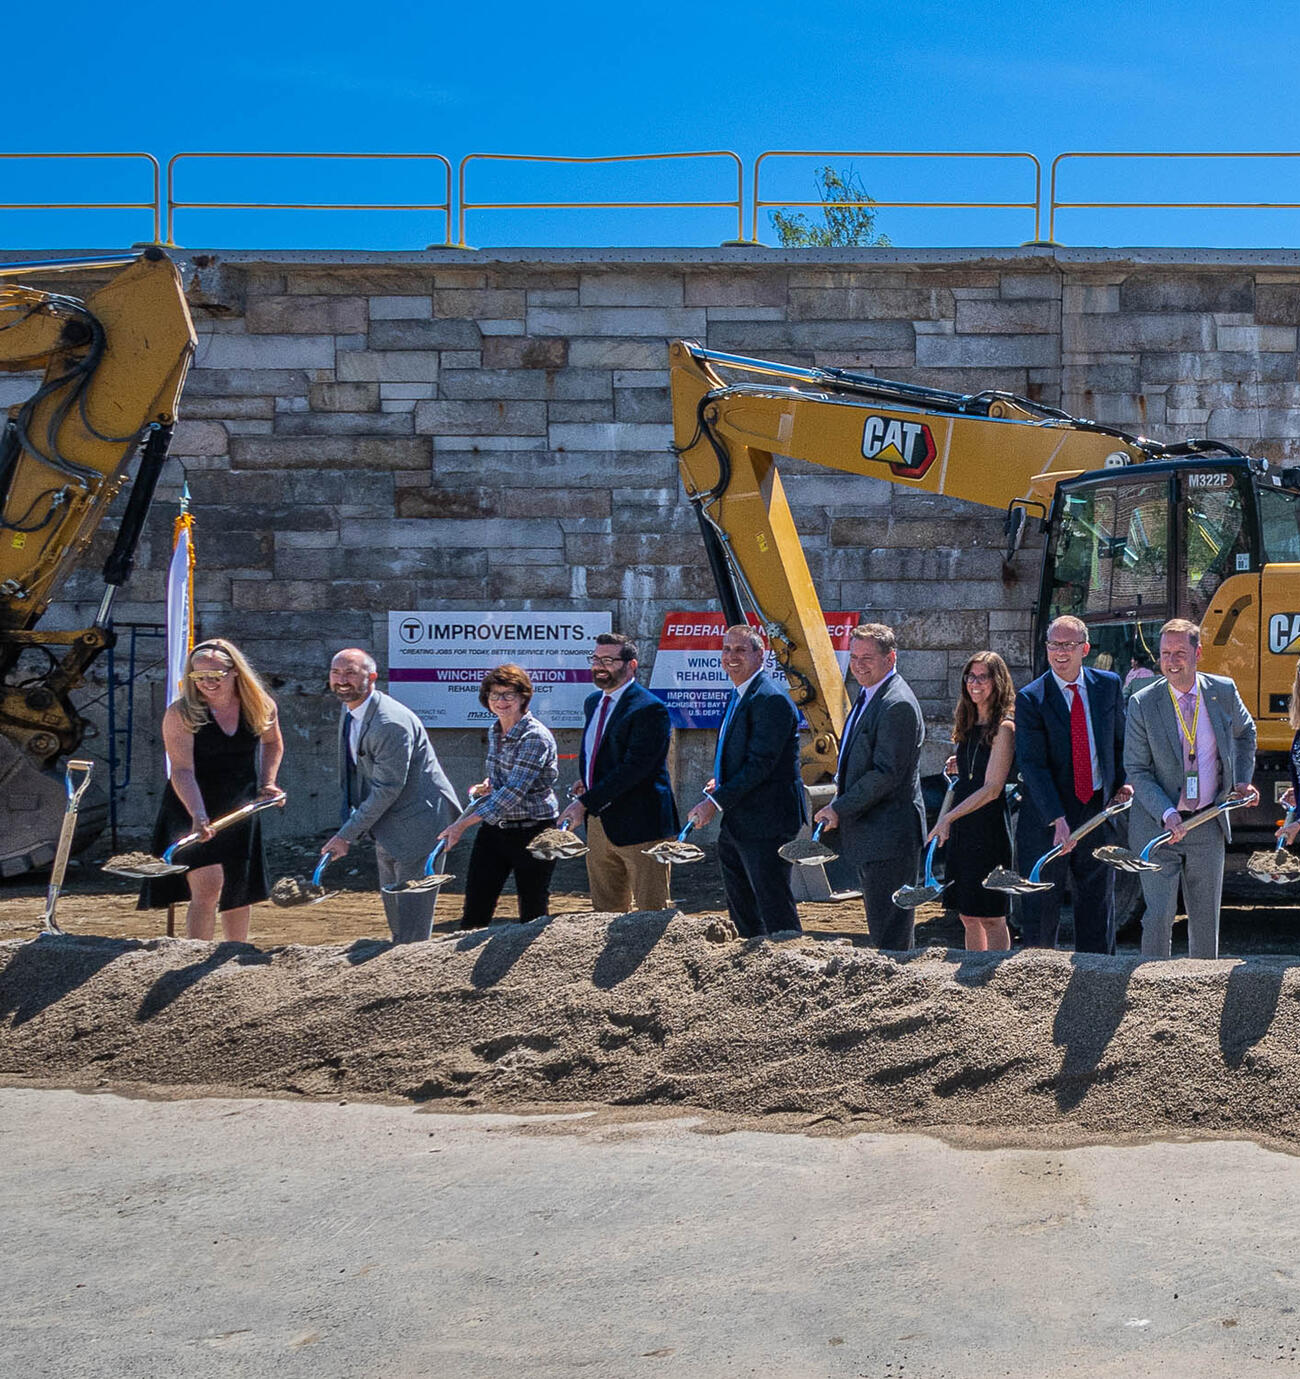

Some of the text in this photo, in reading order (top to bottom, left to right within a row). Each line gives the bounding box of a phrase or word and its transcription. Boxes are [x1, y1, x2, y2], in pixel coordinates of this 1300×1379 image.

[862, 416, 922, 465] CAT
[1188, 473, 1228, 488] M322F
[667, 625, 727, 636] FEDERAL
[688, 658, 723, 668] WINCH
[436, 670, 567, 681] WINCHES TATION
[676, 672, 729, 681] REHABILI
